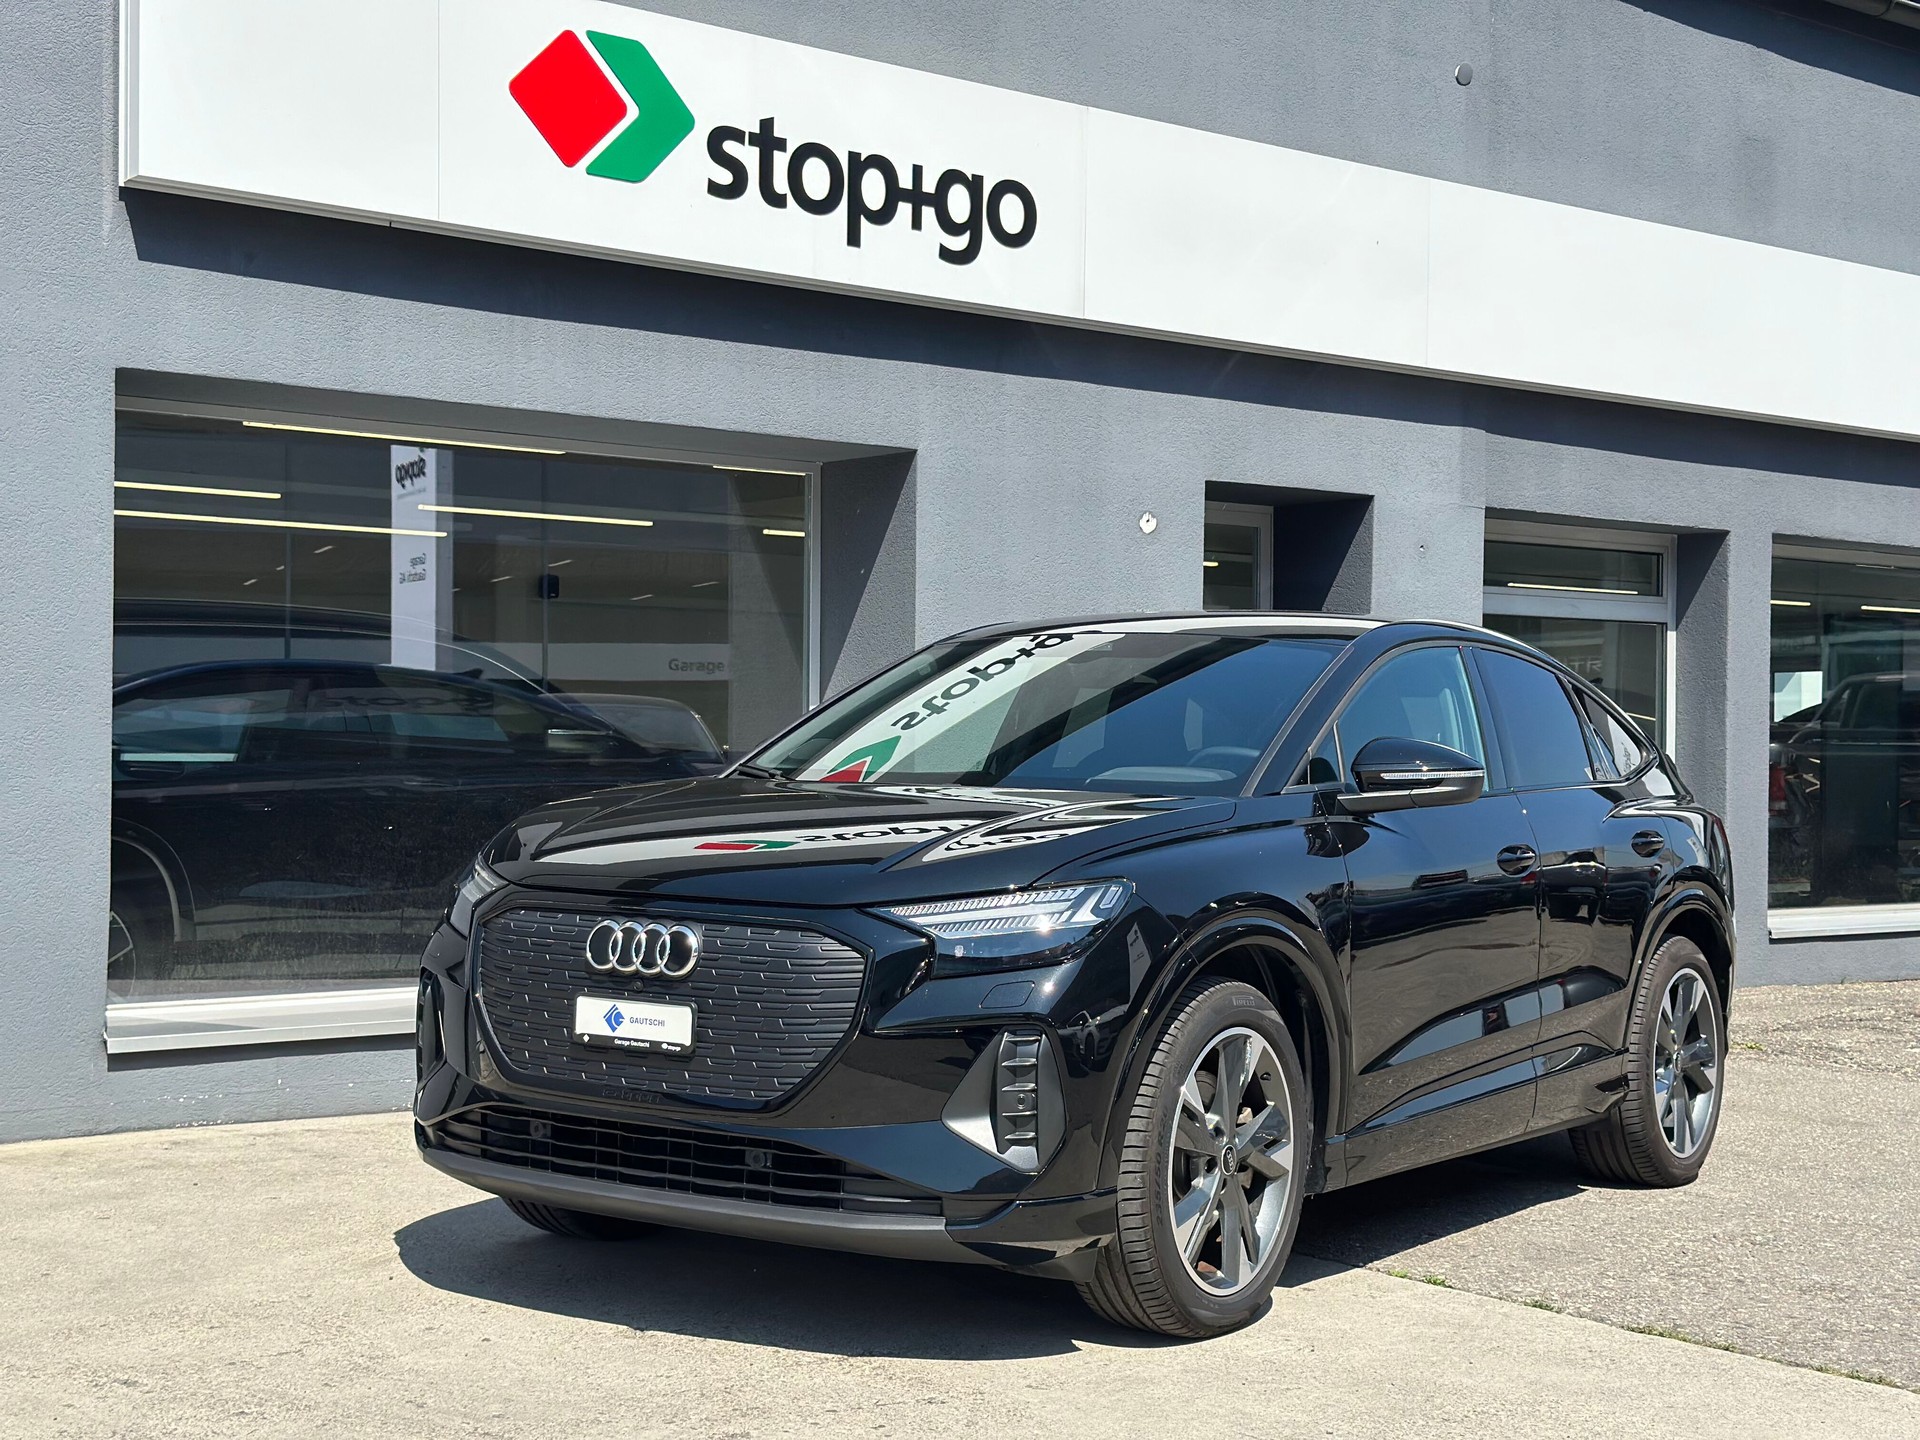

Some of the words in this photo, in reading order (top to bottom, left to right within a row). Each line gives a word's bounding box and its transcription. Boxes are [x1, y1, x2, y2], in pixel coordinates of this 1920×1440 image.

[706, 116, 1037, 266] stop+go
[668, 658, 725, 675] Garage
[629, 1016, 666, 1028] GAUTSCHI
